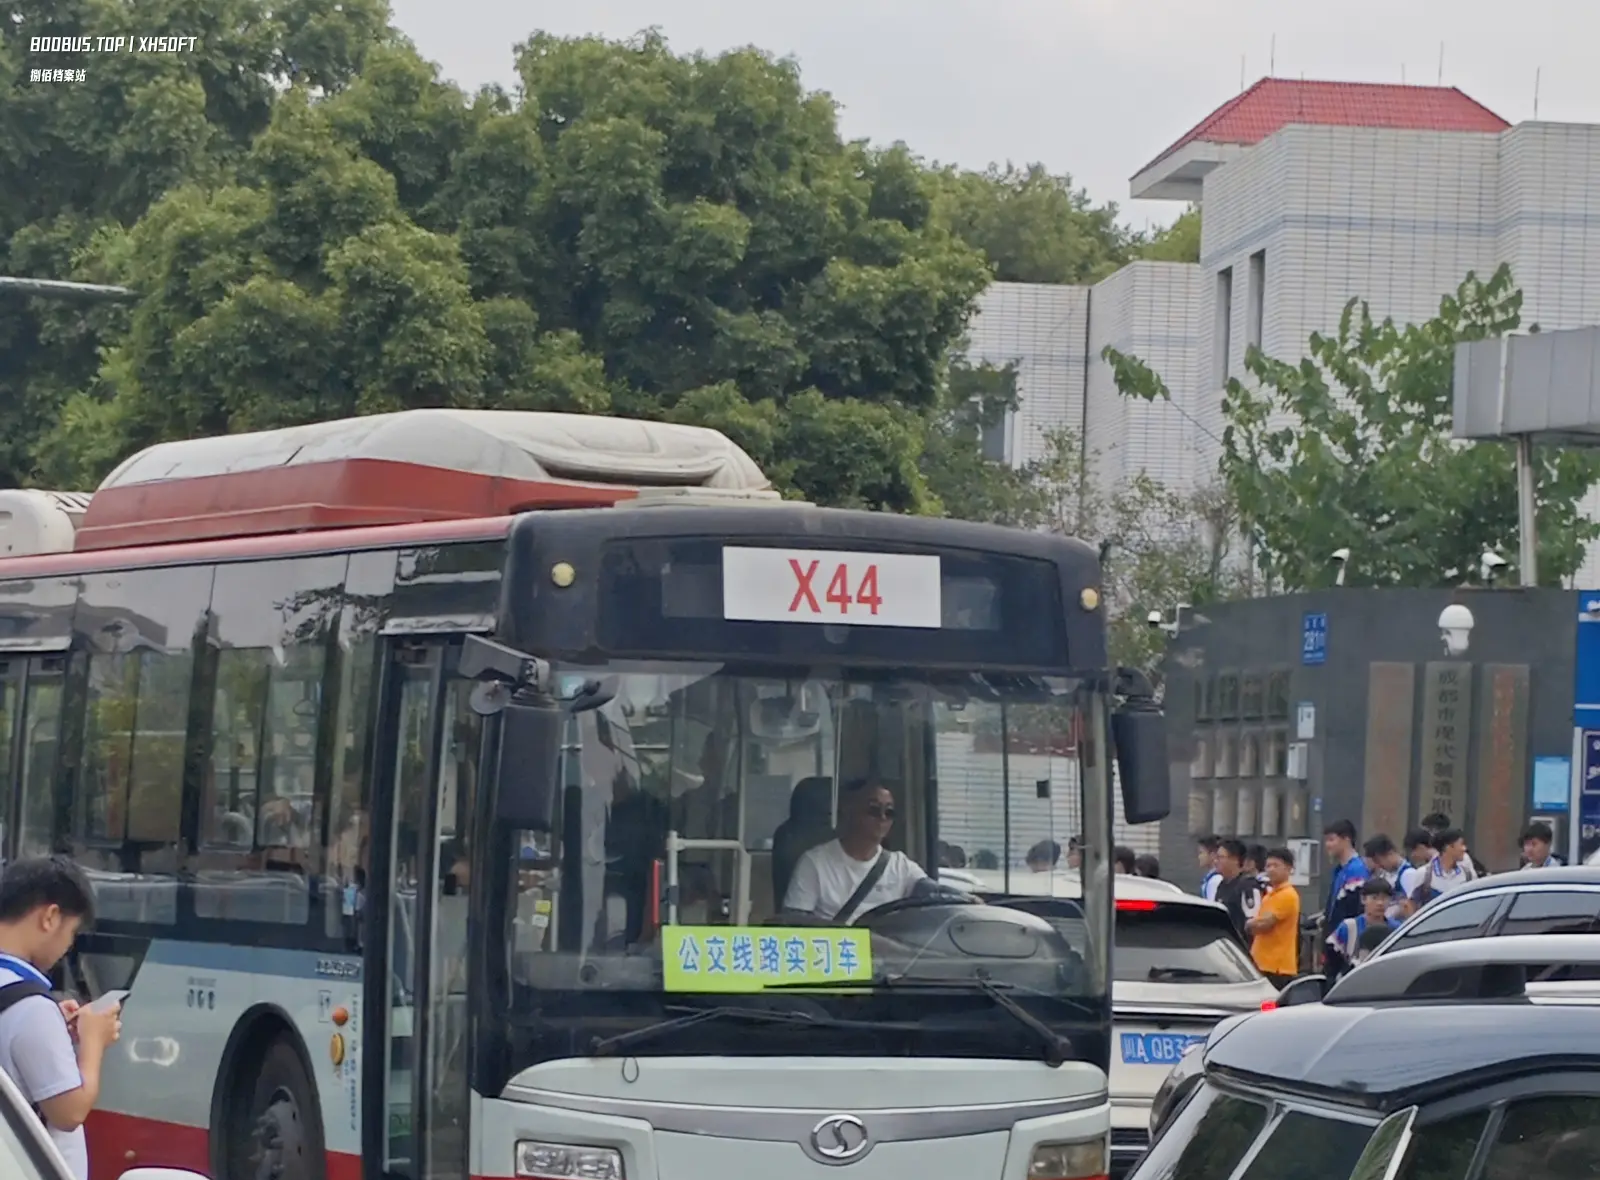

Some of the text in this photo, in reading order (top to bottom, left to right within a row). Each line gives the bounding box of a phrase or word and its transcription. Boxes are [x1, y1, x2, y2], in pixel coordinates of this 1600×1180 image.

[787, 559, 883, 615] X44
[679, 935, 859, 975] 公交线路实习车
